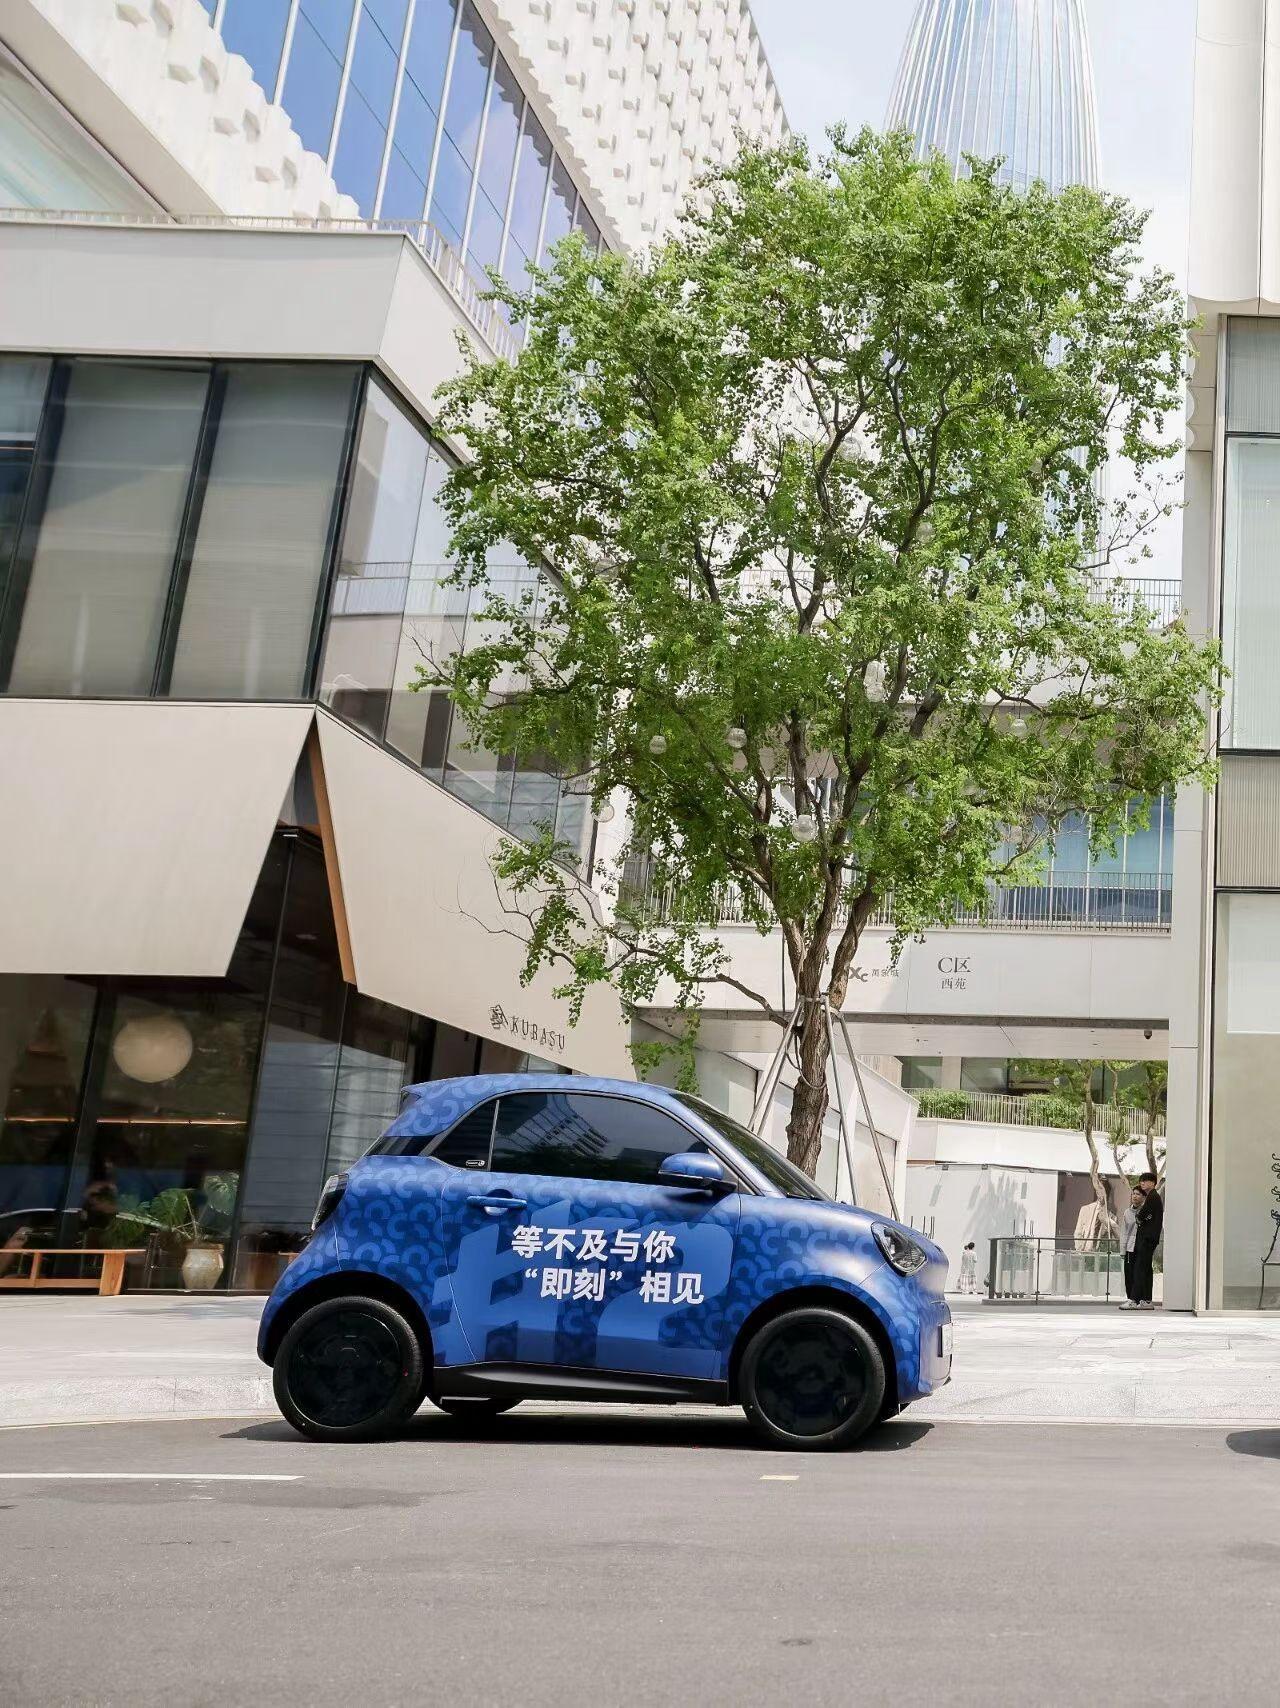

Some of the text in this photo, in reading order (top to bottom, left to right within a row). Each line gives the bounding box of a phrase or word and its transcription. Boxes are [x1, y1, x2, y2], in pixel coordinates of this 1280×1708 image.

[937, 956, 972, 974] C区
[941, 977, 967, 990] 西苑
[511, 1225, 677, 1264] 等不及与你
